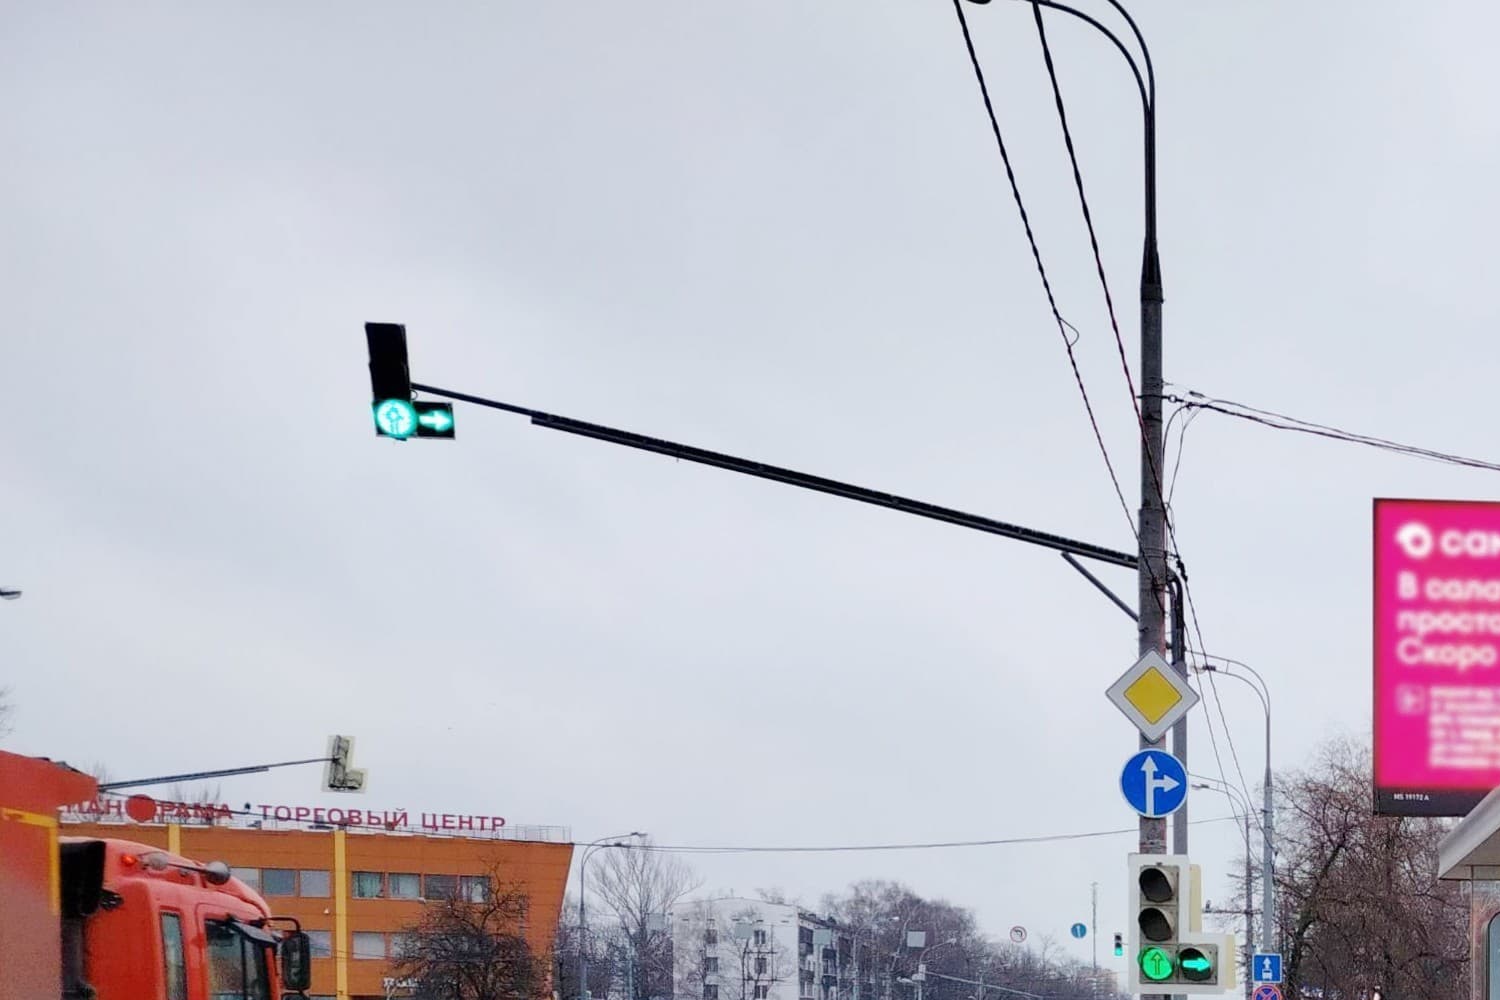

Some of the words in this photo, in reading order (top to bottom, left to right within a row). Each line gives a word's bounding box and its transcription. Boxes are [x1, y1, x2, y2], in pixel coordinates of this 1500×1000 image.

[1398, 571, 1418, 600] В
[1397, 636, 1497, 673] Скоро
[257, 804, 408, 829] ТОРГОВЫЙ
[421, 812, 506, 832] ЦЕНТР
